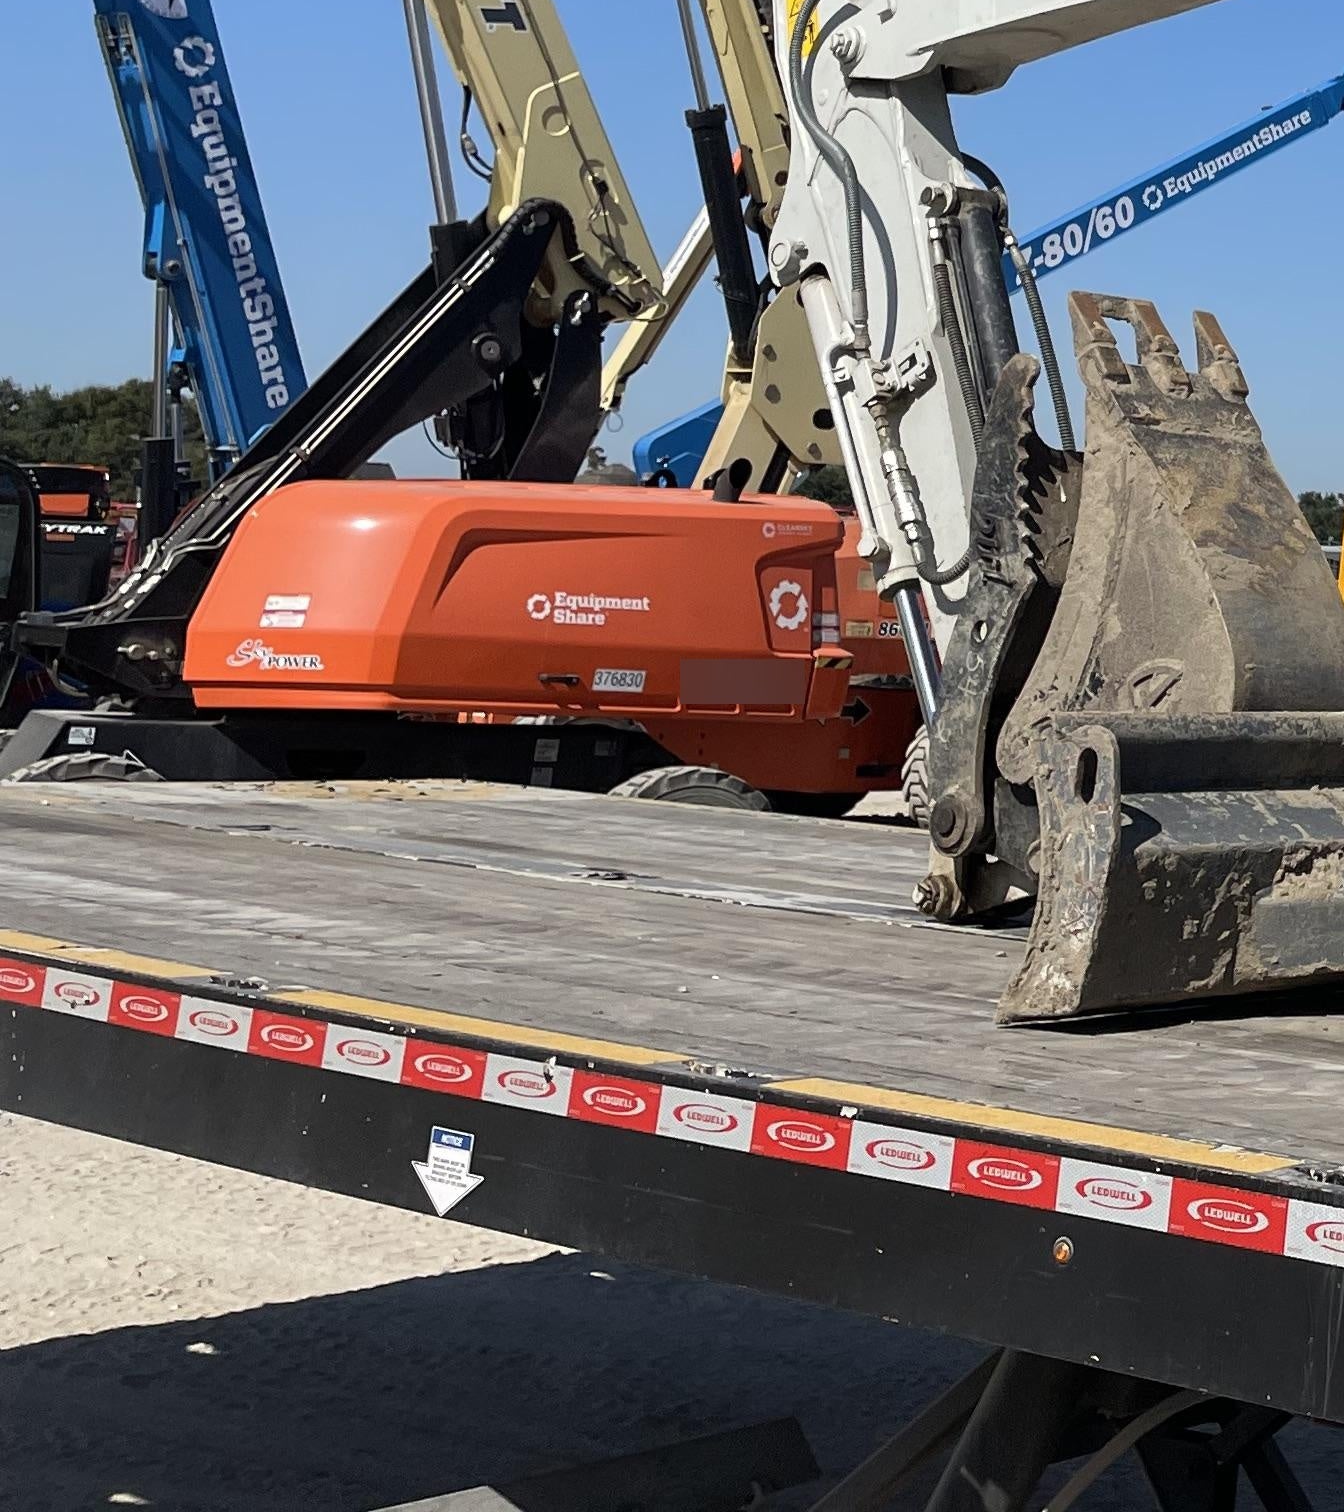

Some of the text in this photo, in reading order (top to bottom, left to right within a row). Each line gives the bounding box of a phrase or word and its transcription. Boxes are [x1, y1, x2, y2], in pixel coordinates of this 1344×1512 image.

[1163, 108, 1312, 198] EquipmentShare
[189, 80, 290, 409] EquipmentShare
[554, 592, 650, 611] Equipment
[553, 609, 606, 626] Share
[594, 671, 644, 688] 376830
[509, 1077, 545, 1092] LEDWELL
[596, 1093, 632, 1109] LEDWELL
[687, 1110, 724, 1126] LEDWELL
[781, 1128, 821, 1144] LEDWELL
[880, 1146, 922, 1163] LEDWELL
[983, 1165, 1027, 1182] LEDWELL
[1091, 1185, 1137, 1203] LEDWELL
[1204, 1207, 1251, 1225] LEDWELL
